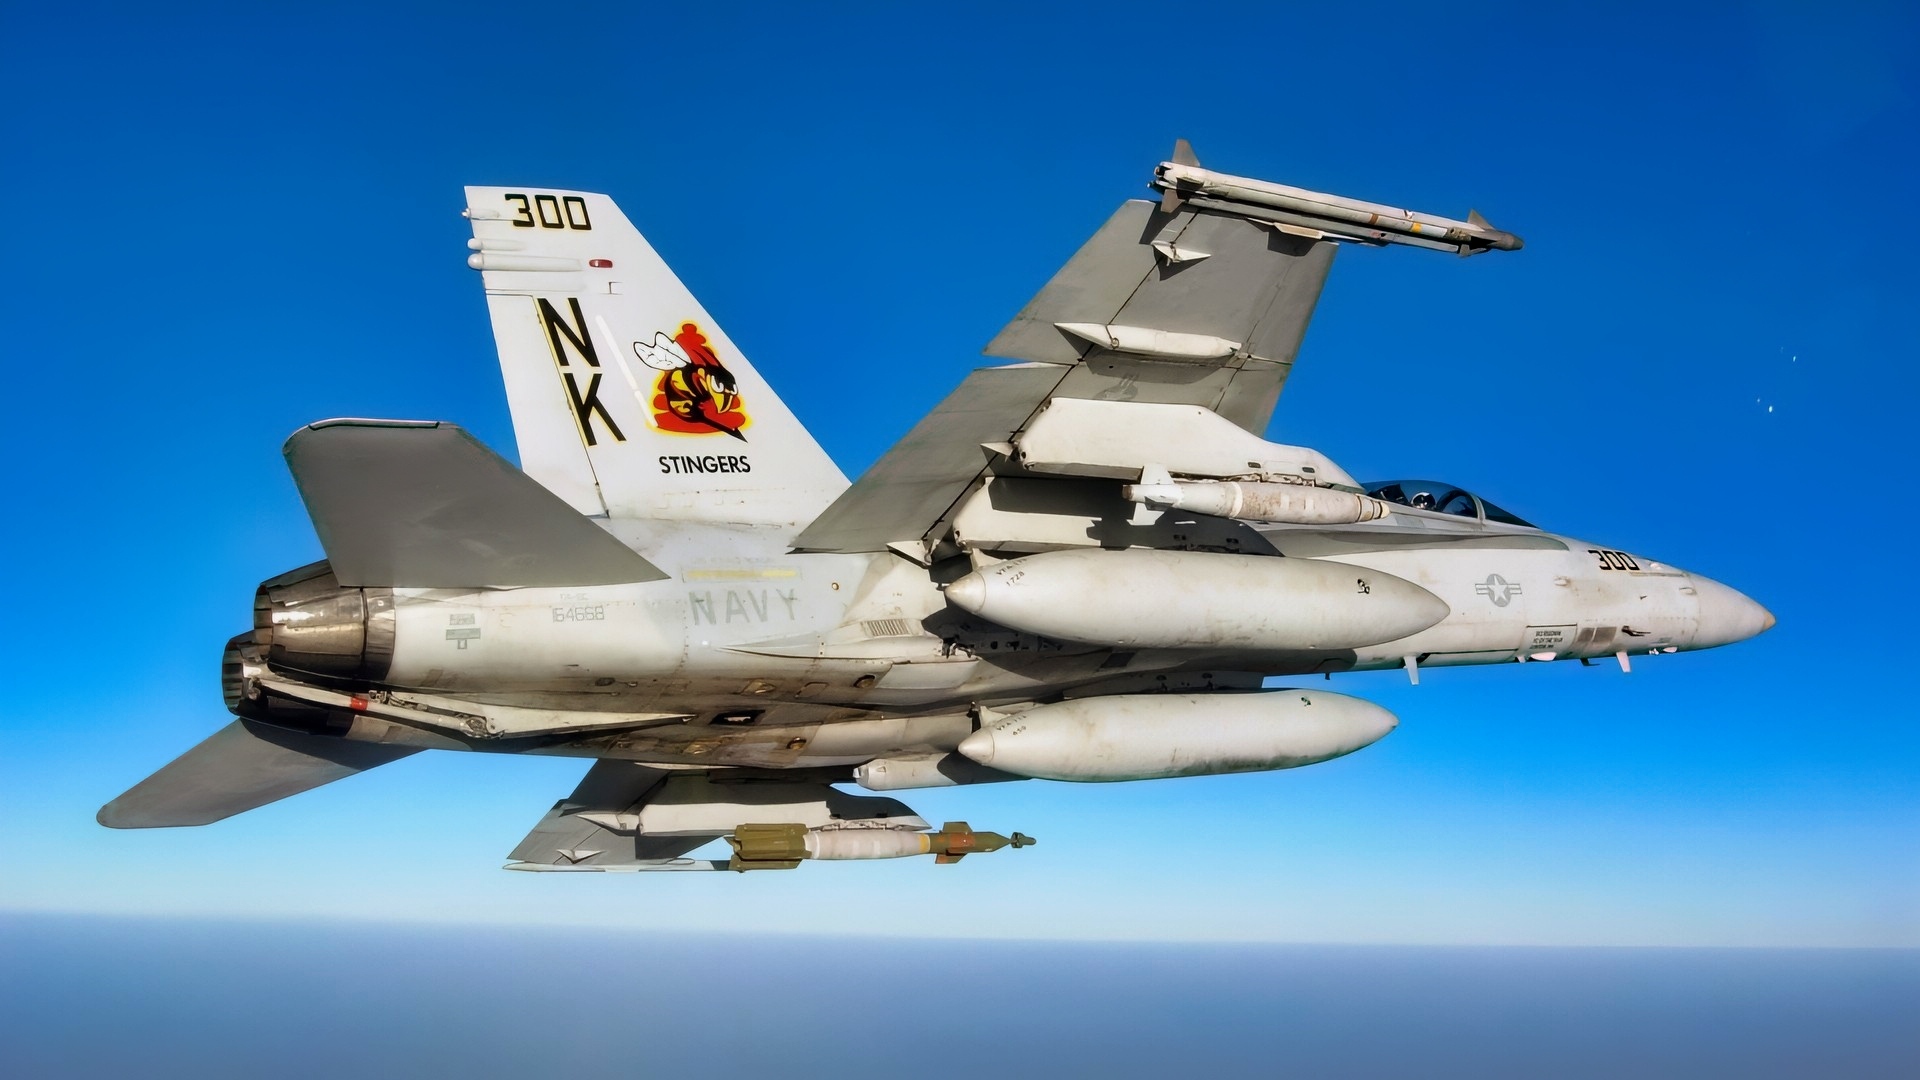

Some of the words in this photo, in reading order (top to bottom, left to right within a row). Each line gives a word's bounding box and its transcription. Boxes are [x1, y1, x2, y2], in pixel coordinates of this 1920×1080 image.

[504, 193, 592, 230] 300
[658, 455, 751, 474] STINGERS
[1587, 549, 1640, 571] 300
[688, 588, 798, 626] NAVY
